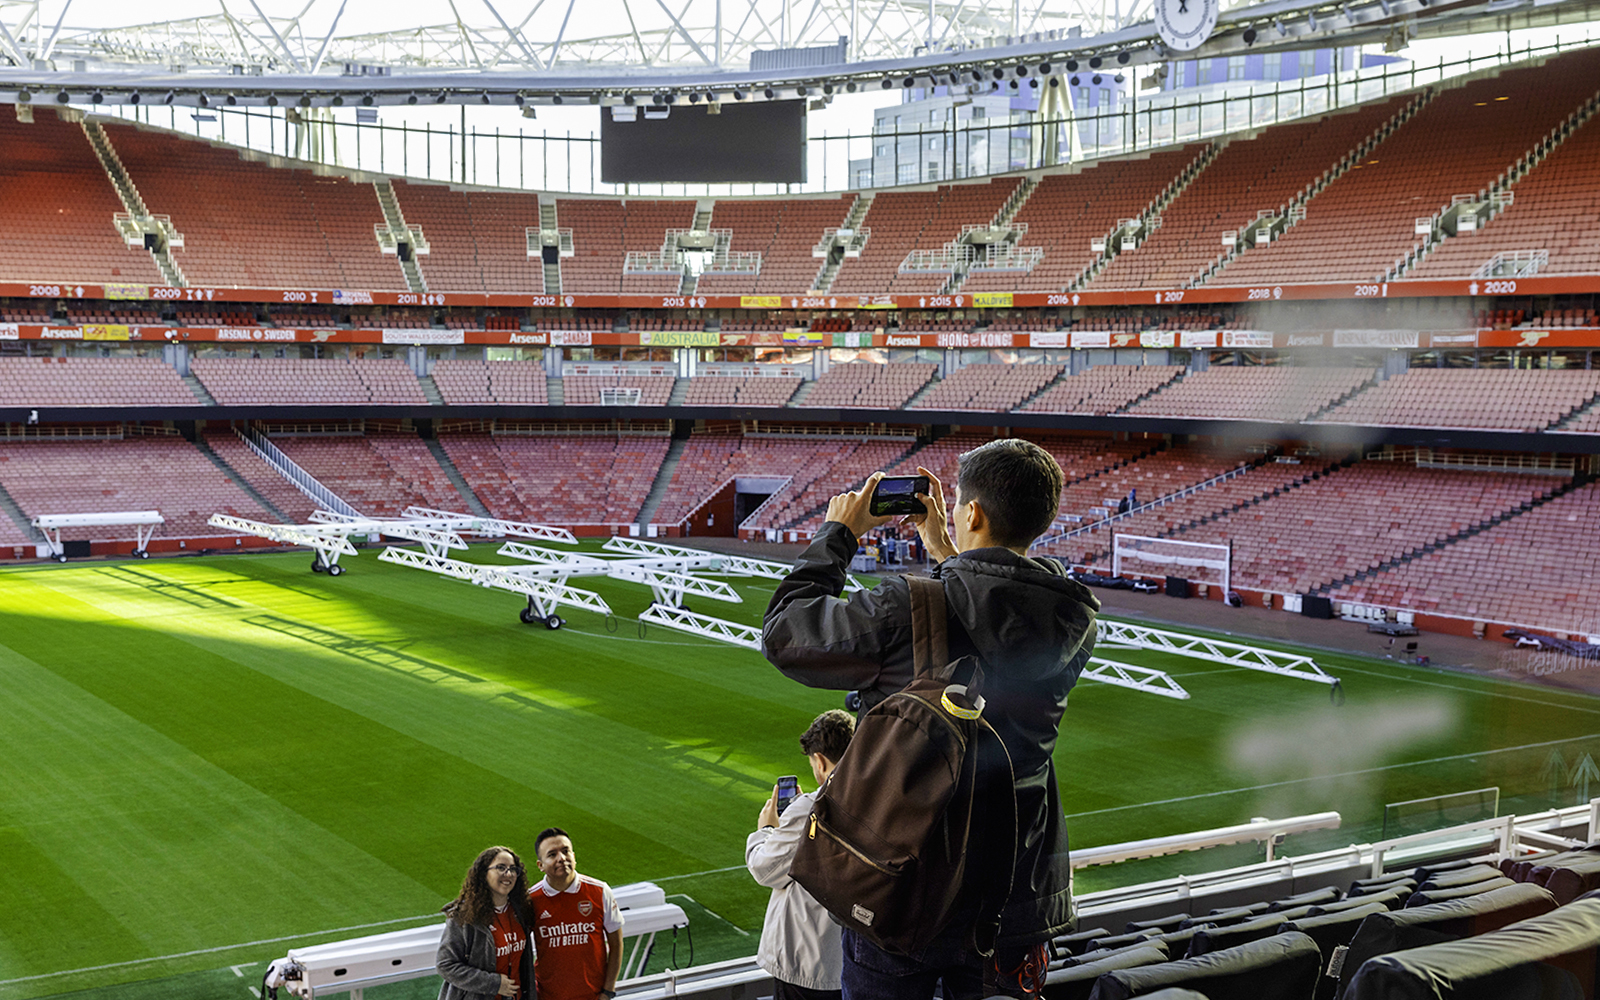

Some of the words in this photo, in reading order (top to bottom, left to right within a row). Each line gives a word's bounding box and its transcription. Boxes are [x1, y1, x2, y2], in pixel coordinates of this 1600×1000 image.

[29, 285, 60, 296] 2008
[153, 287, 182, 299] 2009
[1354, 284, 1379, 296] 2019
[1484, 280, 1517, 294] 2020
[283, 291, 307, 301] 2010
[397, 294, 418, 304] 2011
[1047, 294, 1069, 305] 2016
[1164, 291, 1185, 302] 2017
[1247, 288, 1270, 300] 2018
[532, 296, 556, 306] 2012
[662, 297, 685, 307] 2013
[801, 297, 826, 307] 2014
[929, 296, 952, 307] 2015
[974, 295, 1012, 306] MALDIVES
[40, 326, 83, 339] Arsenal
[218, 328, 252, 341] ARSENAL
[264, 329, 296, 341] SWEDEN
[384, 333, 407, 341] SOUTH
[408, 333, 429, 341] WALES
[509, 332, 547, 344] Arsenal
[562, 332, 590, 344] CANADA
[653, 333, 719, 345] AUSTRALIA
[886, 334, 921, 346] Arsenal
[942, 332, 969, 347] HONG
[980, 332, 1009, 347] KONG
[1286, 333, 1323, 346] Arsenal
[539, 921, 596, 938] Emirates
[549, 937, 561, 948] FLY
[562, 934, 589, 946] BETTER
